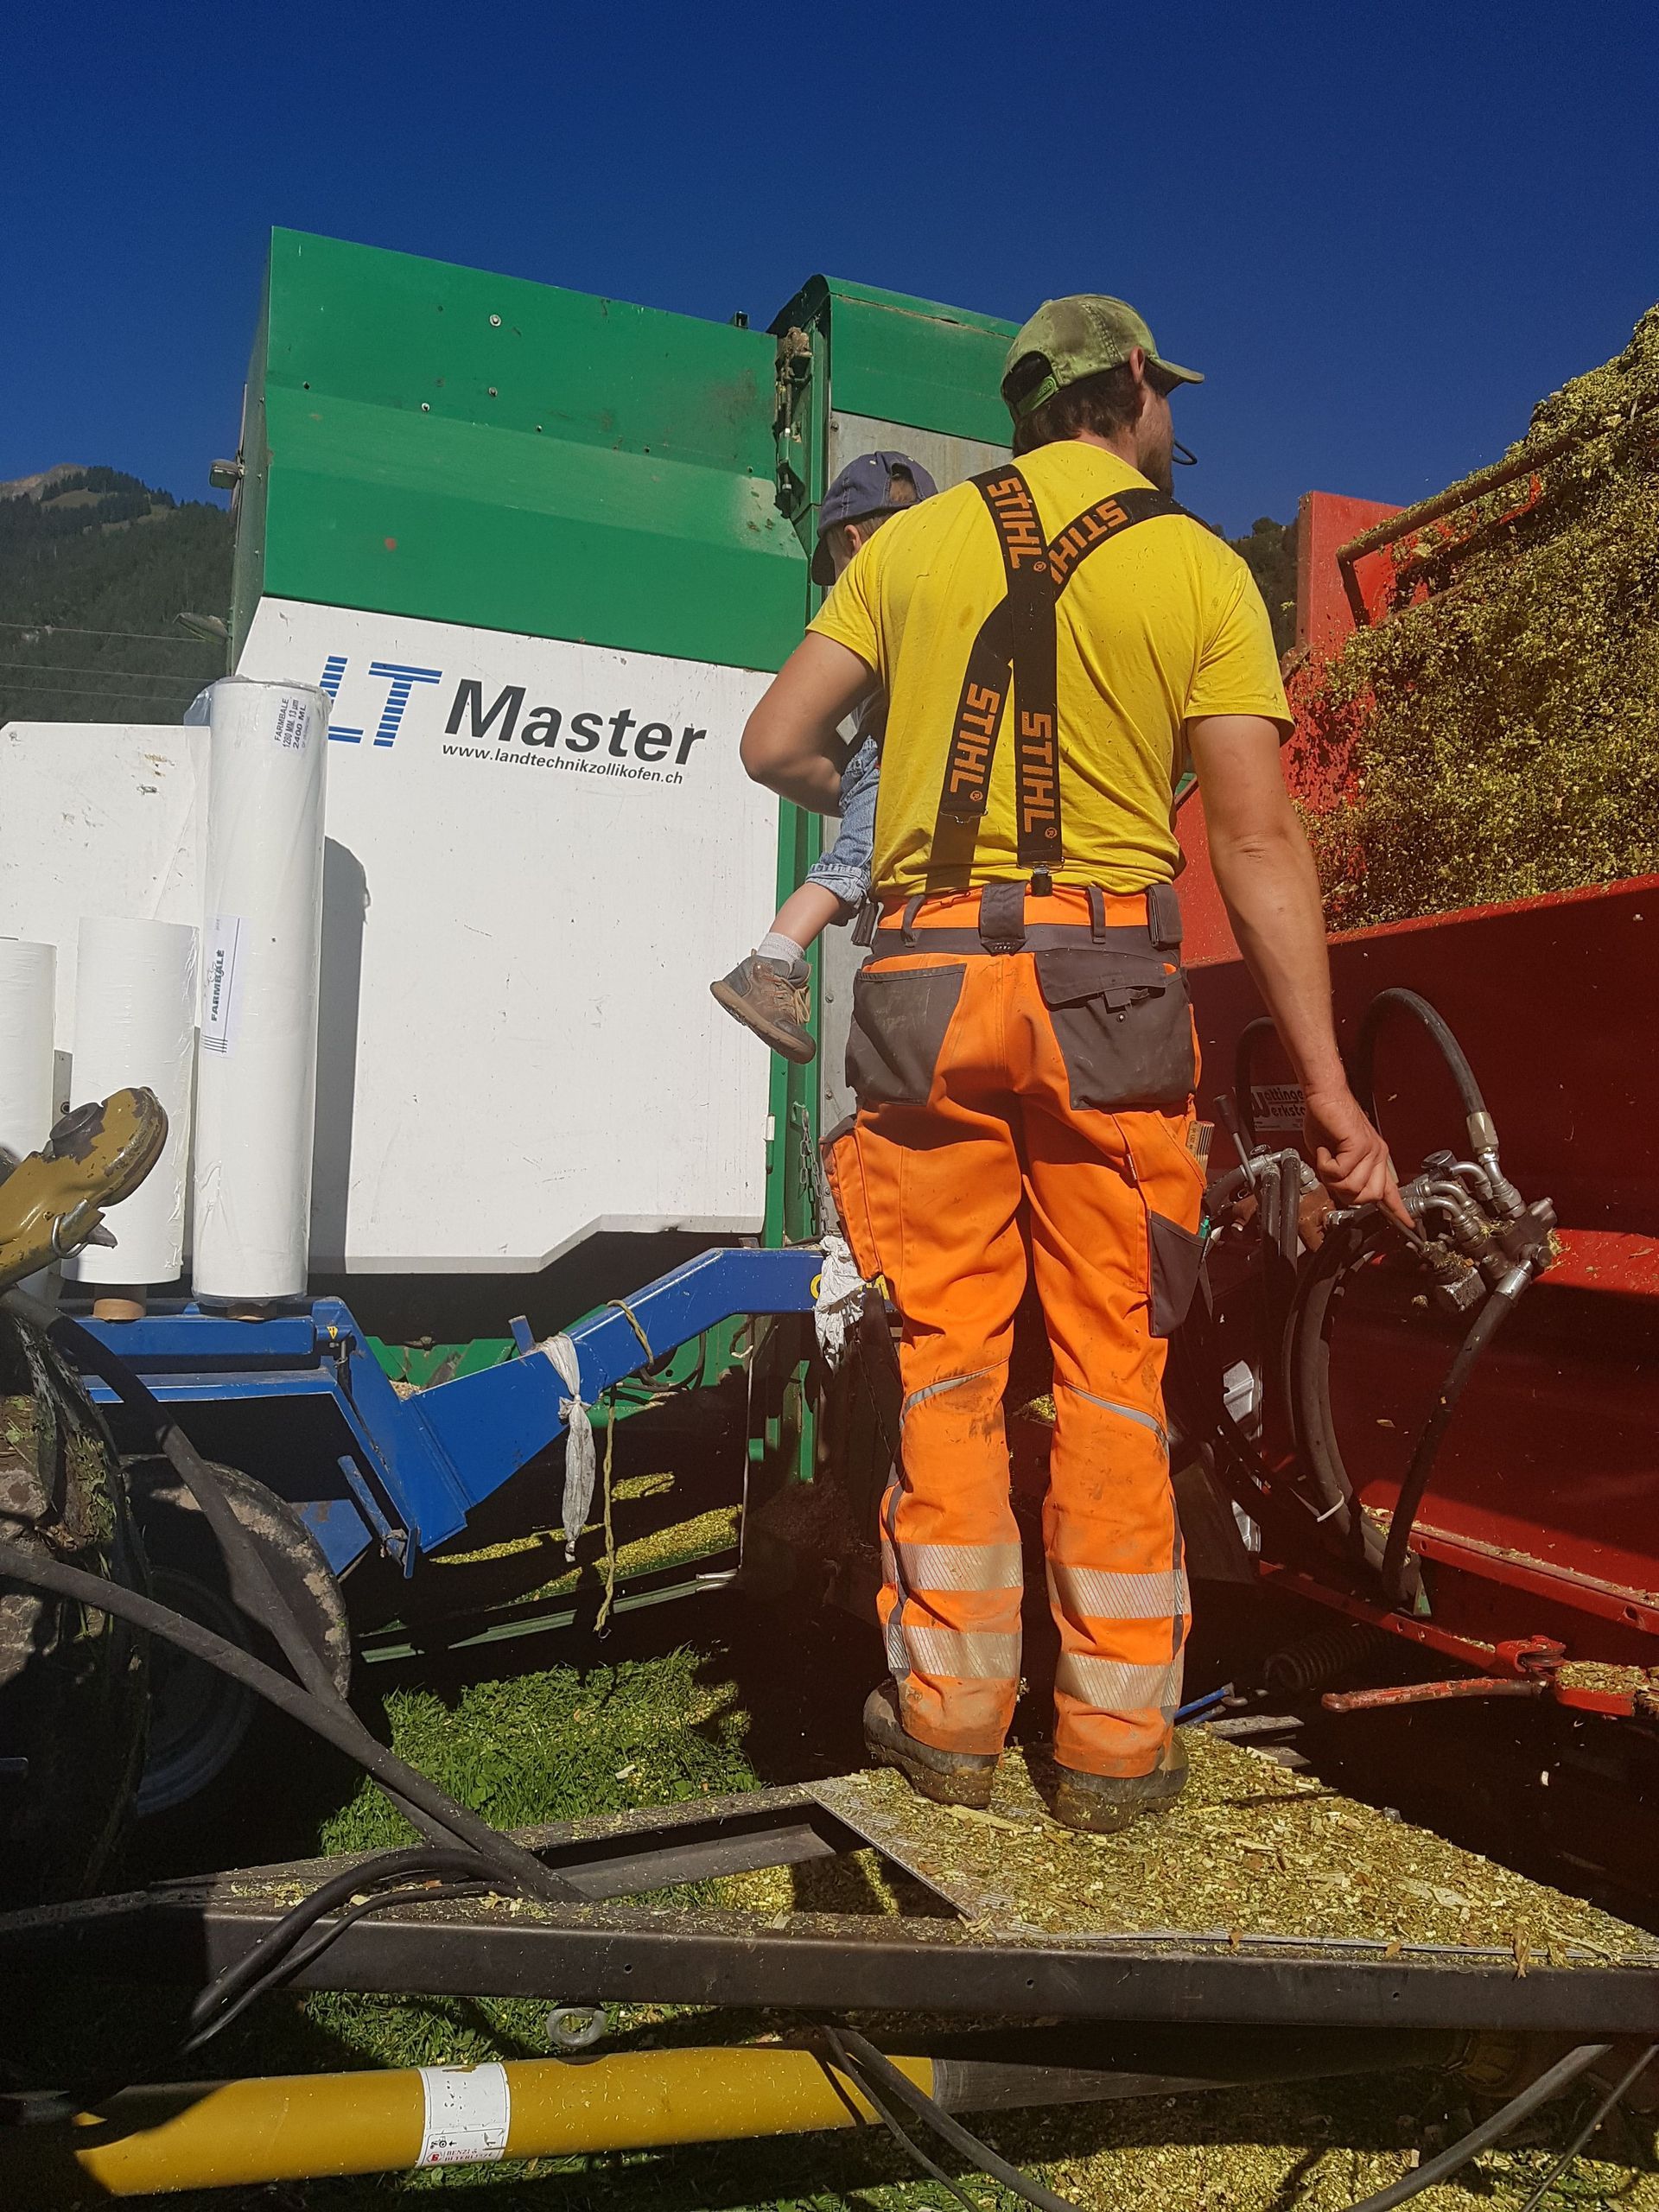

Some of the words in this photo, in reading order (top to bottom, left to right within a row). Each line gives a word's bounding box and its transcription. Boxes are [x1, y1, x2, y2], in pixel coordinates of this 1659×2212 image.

[987, 477, 1042, 569] STIHL
[274, 697, 289, 741] FARMBALE
[293, 723, 302, 750] 2400
[298, 704, 307, 721] ML
[320, 655, 442, 747] LT
[444, 678, 707, 766] Master
[950, 683, 1000, 792] STIHL
[442, 742, 683, 785] www.landtechnikzollikofen.ch
[1021, 711, 1055, 832] STIHL
[211, 950, 225, 1021] FARMBALE
